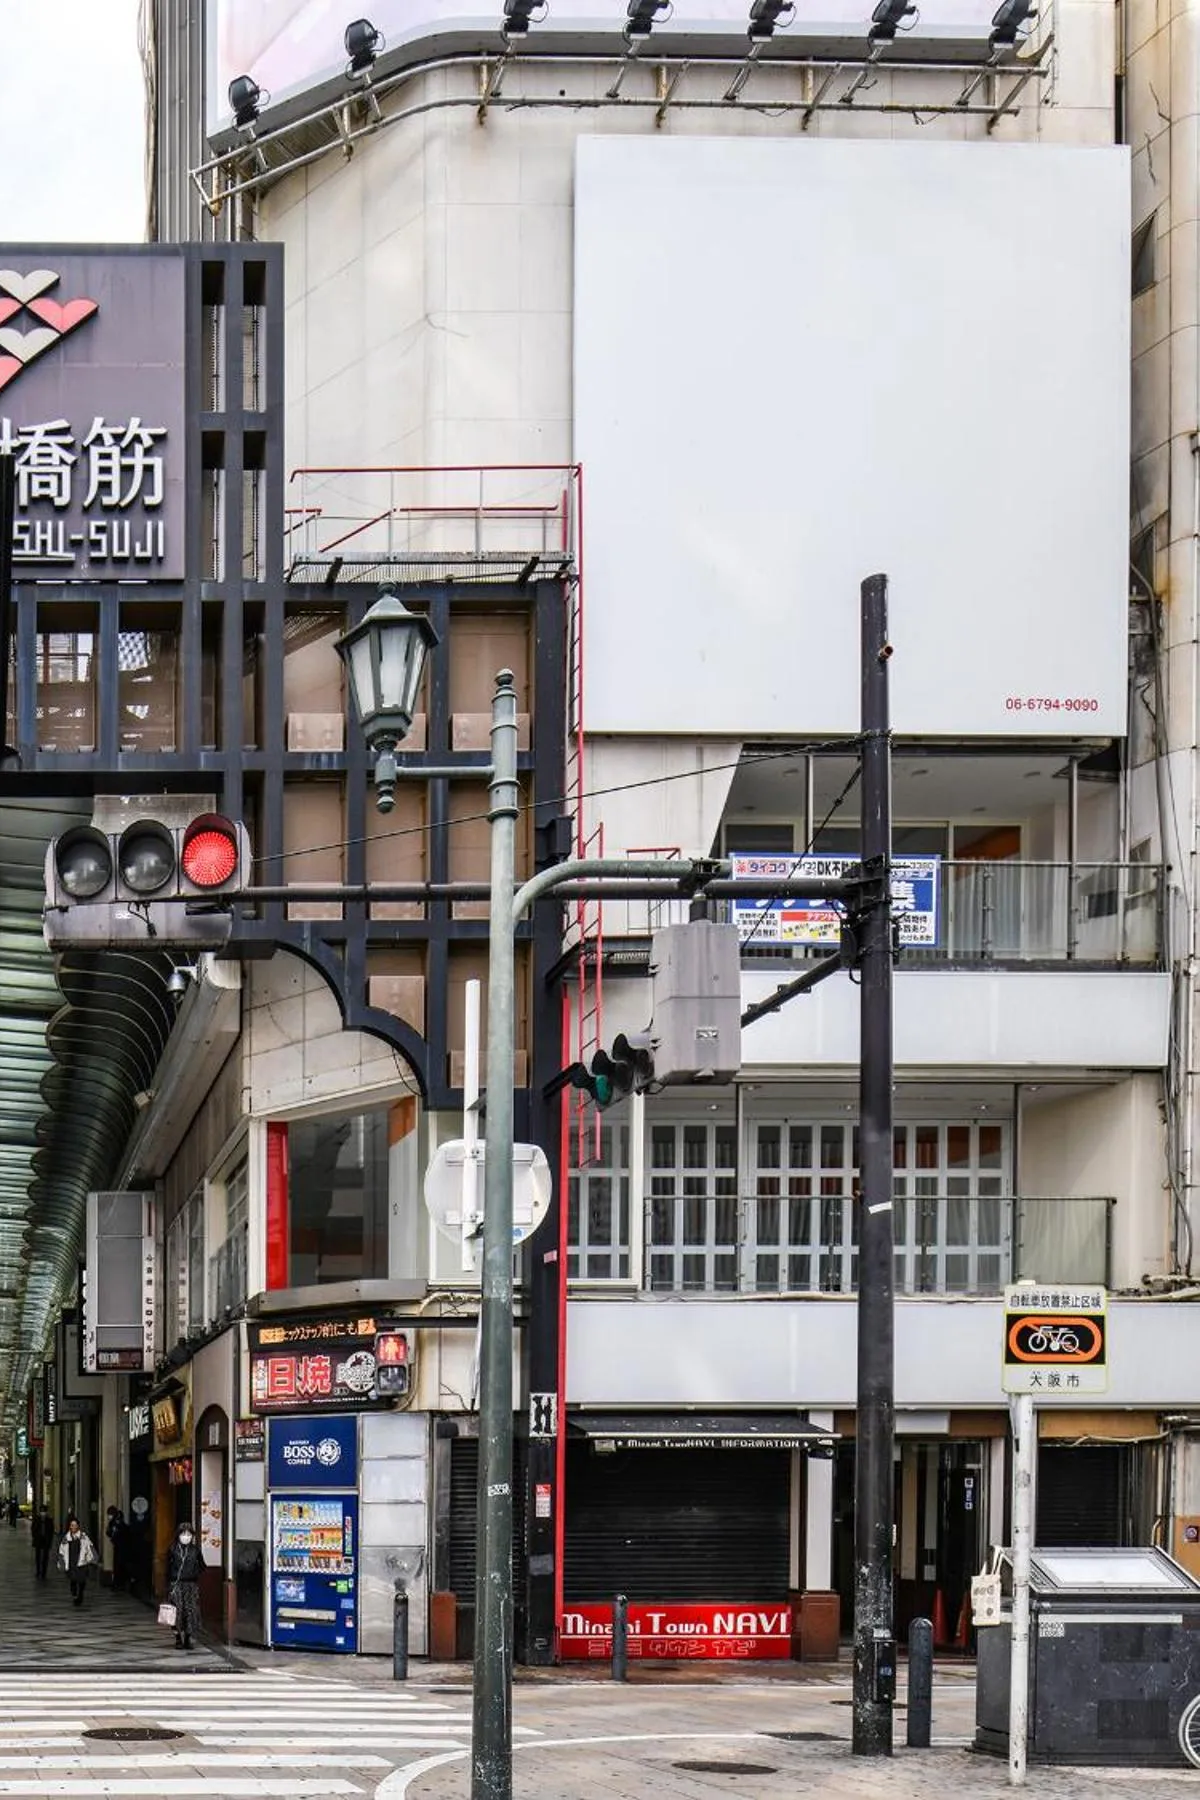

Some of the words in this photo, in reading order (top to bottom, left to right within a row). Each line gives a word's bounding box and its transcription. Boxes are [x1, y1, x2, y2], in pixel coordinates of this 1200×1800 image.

[1005, 698, 1099, 712] 06-6794-9090
[1010, 1293, 1102, 1309] 自転車放置禁止区域
[268, 1355, 331, 1396] 日焼
[1030, 1374, 1081, 1388] 大阪市
[284, 1446, 315, 1458] BOSS
[646, 1612, 708, 1635] Town
[713, 1612, 787, 1635] NAVI
